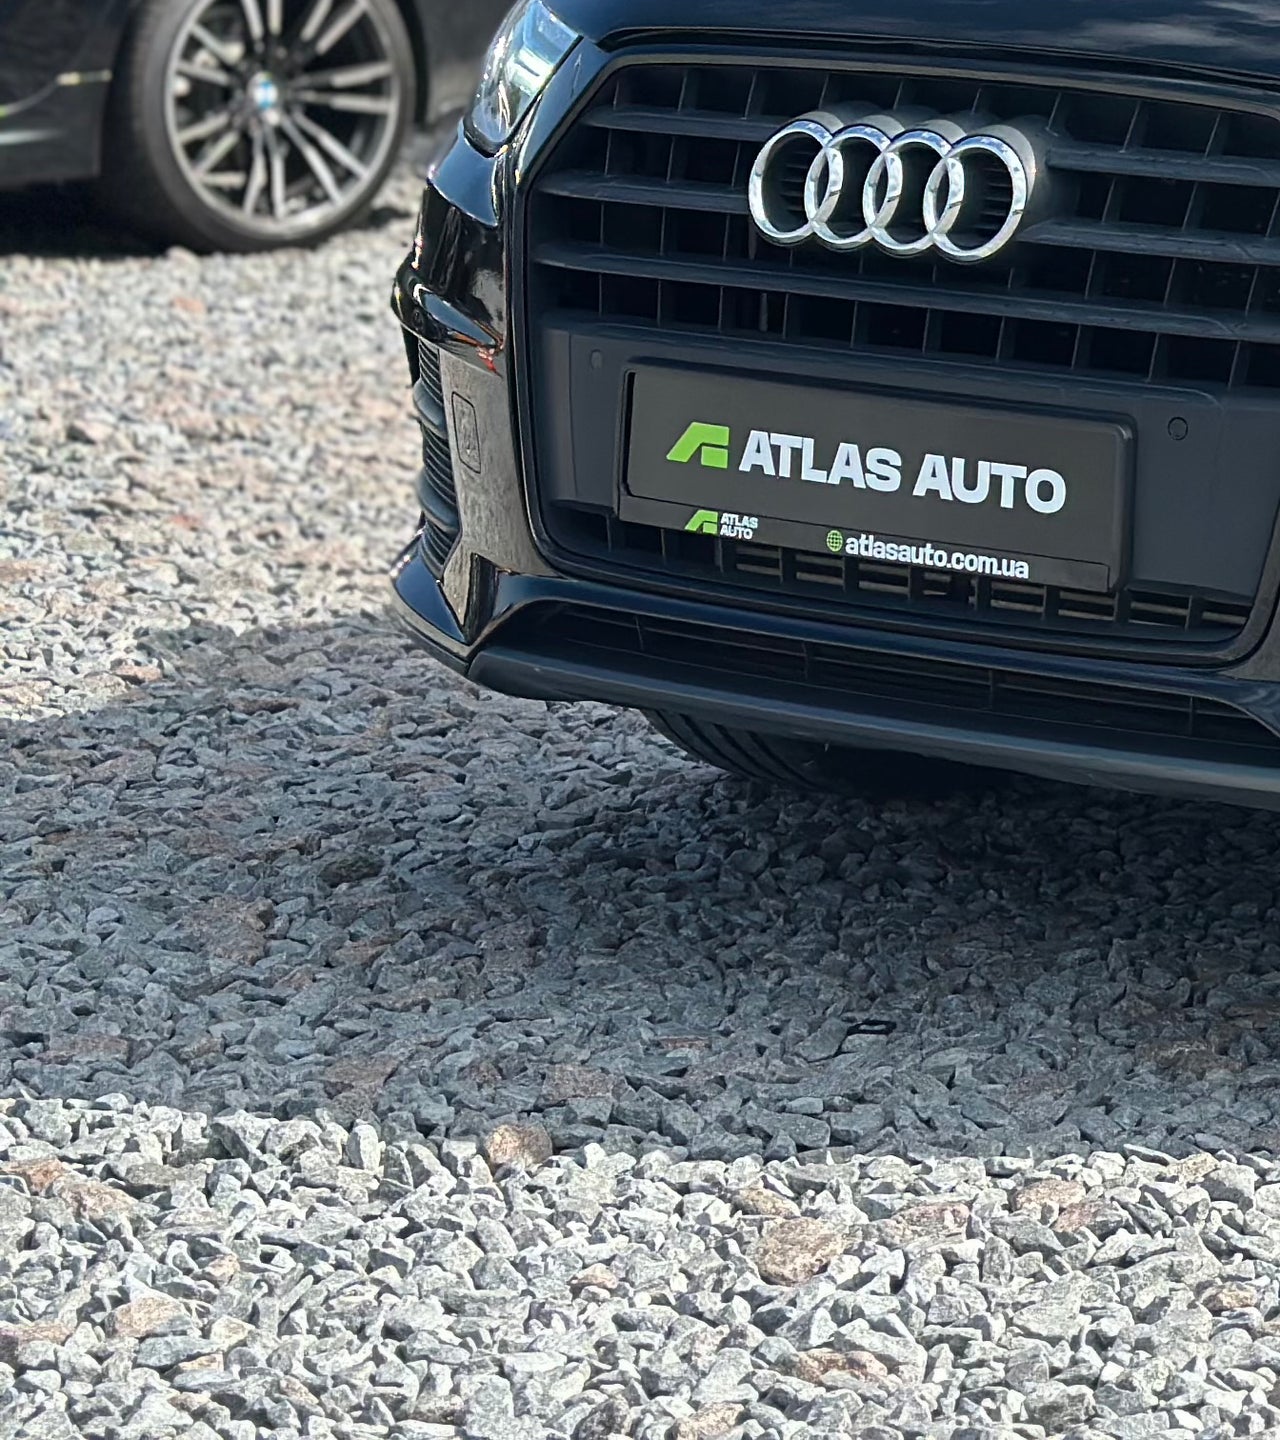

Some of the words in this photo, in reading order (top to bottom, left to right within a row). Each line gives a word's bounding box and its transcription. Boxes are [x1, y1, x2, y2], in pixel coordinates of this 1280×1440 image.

[739, 429, 902, 492] ATLAS
[912, 453, 1066, 514] AUTO
[719, 524, 754, 540] AUTO
[720, 512, 759, 530] ATLAS
[845, 533, 1030, 579] atlasauto.com.ua
